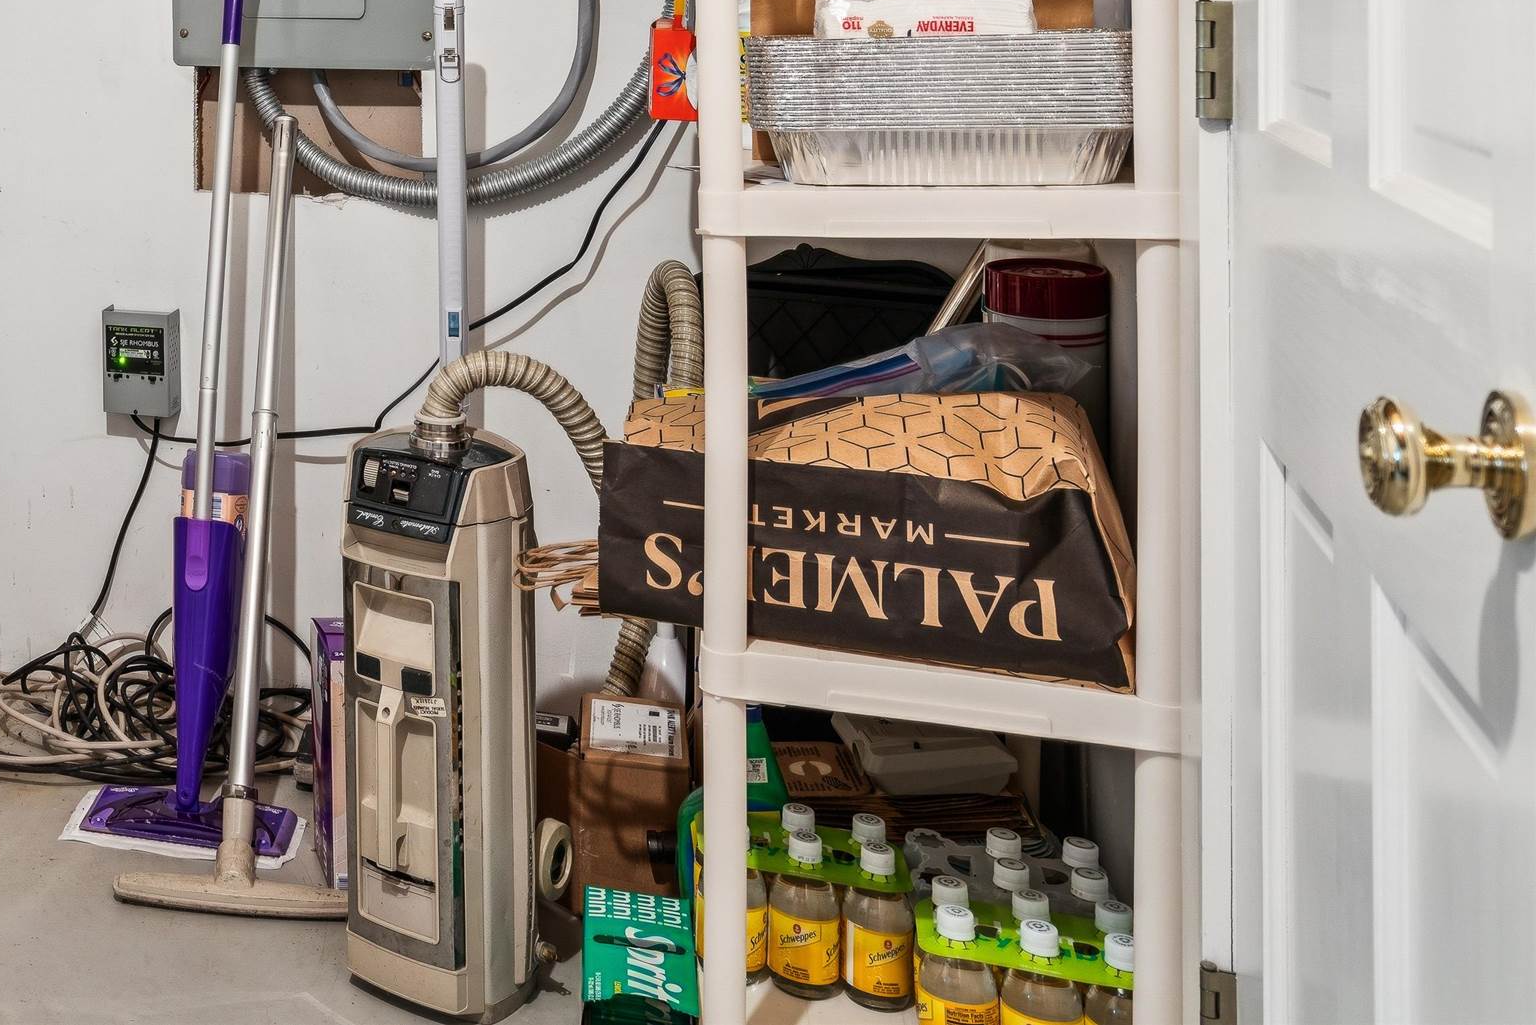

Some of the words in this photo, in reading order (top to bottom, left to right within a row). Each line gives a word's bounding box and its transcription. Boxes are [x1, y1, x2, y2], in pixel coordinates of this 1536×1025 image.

[842, 21, 862, 30] 110
[916, 21, 974, 32] EVERYDAY
[130, 339, 160, 347] RHOMBUS
[355, 510, 384, 527] Control
[399, 520, 440, 535] Automatic
[748, 505, 934, 545] MARKET
[644, 532, 1063, 641] PALME'S
[588, 886, 613, 918] mini
[612, 890, 638, 921] mini
[637, 893, 664, 925] mini
[662, 897, 689, 930] mini
[779, 930, 817, 946] Schweppes
[625, 926, 683, 1004] Sprit
[868, 943, 905, 965] Schweppes
[947, 1009, 970, 1018] Nutrition
